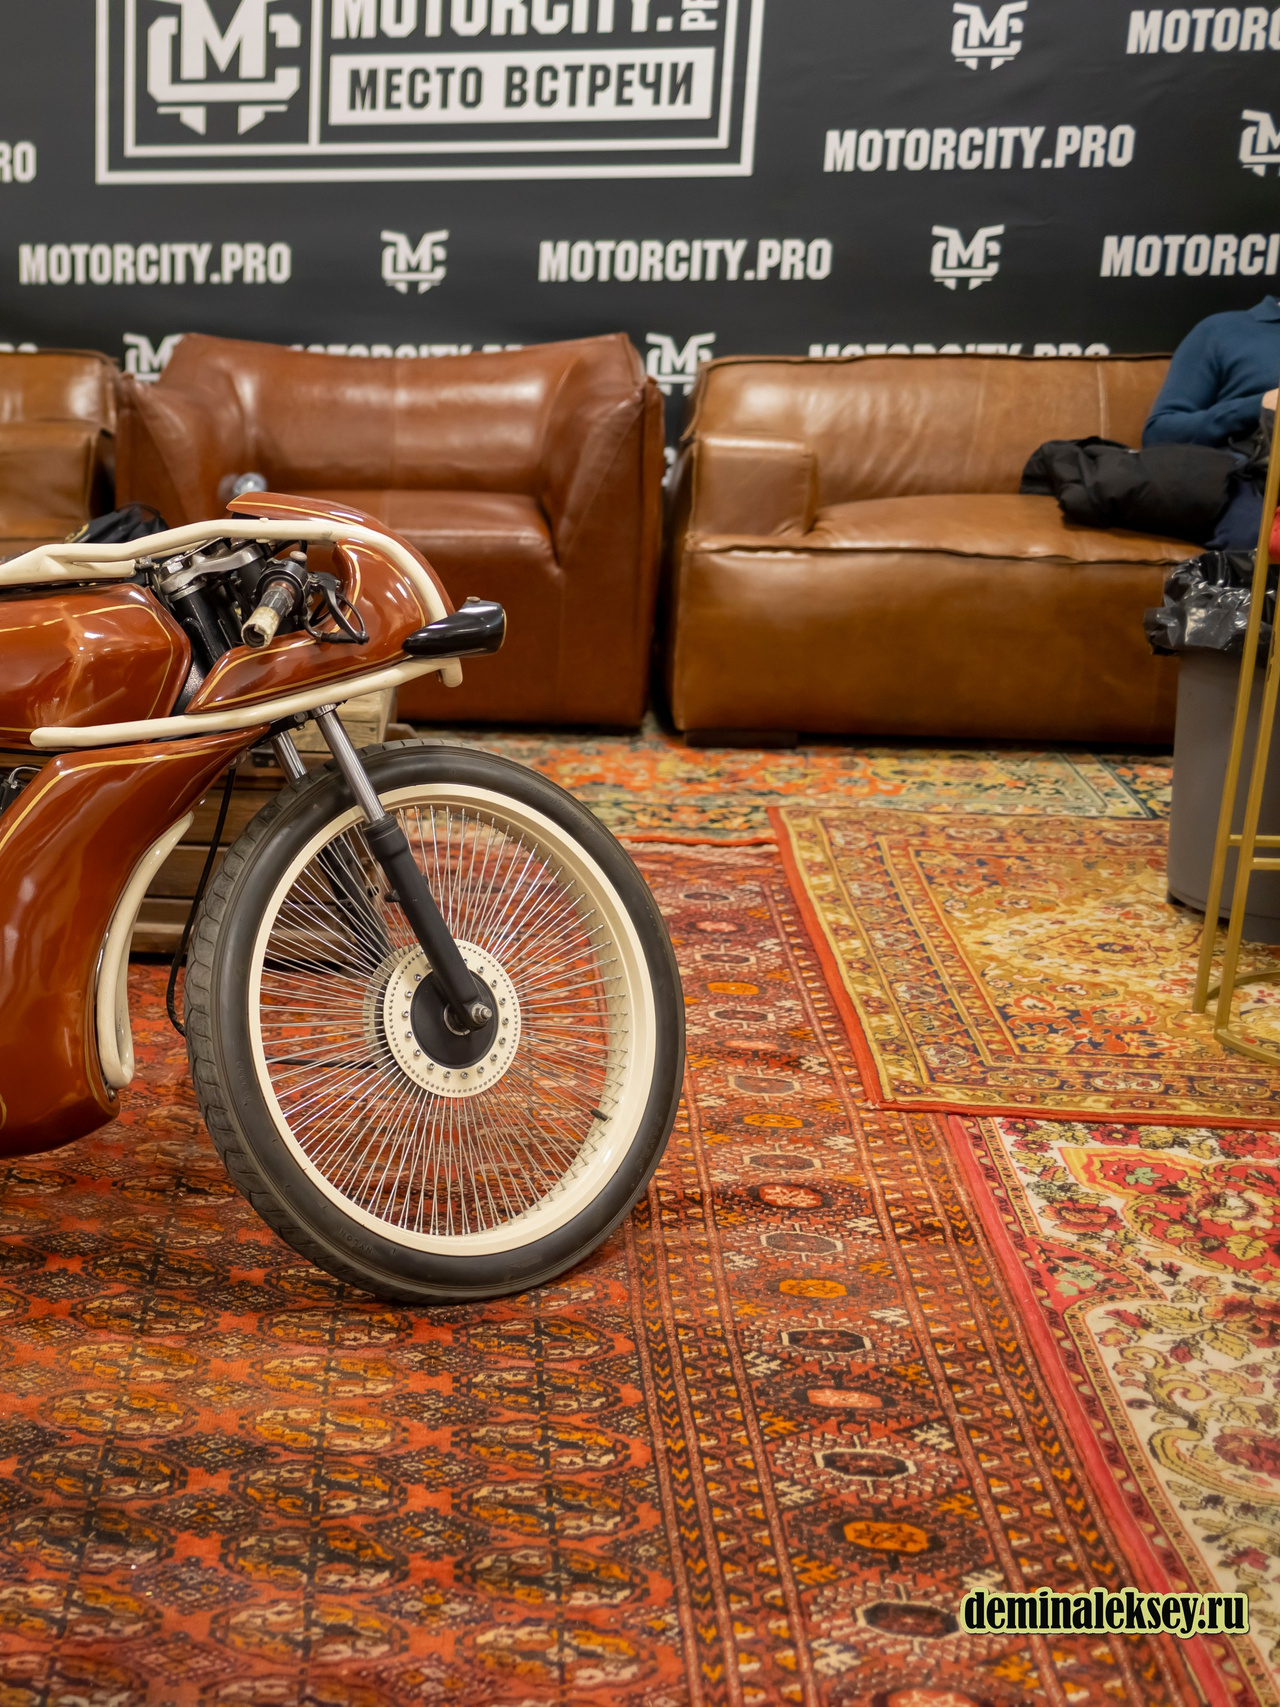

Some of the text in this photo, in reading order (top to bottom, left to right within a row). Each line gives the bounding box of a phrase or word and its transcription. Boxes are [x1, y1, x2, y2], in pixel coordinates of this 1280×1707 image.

[349, 62, 695, 111] МЕСТО ВСТРЕЧИ
[823, 125, 1136, 172] MOTORCITY.PRO
[19, 243, 291, 284] MOTORCITY.PRO
[538, 239, 832, 281] MOTORCITY.PRO
